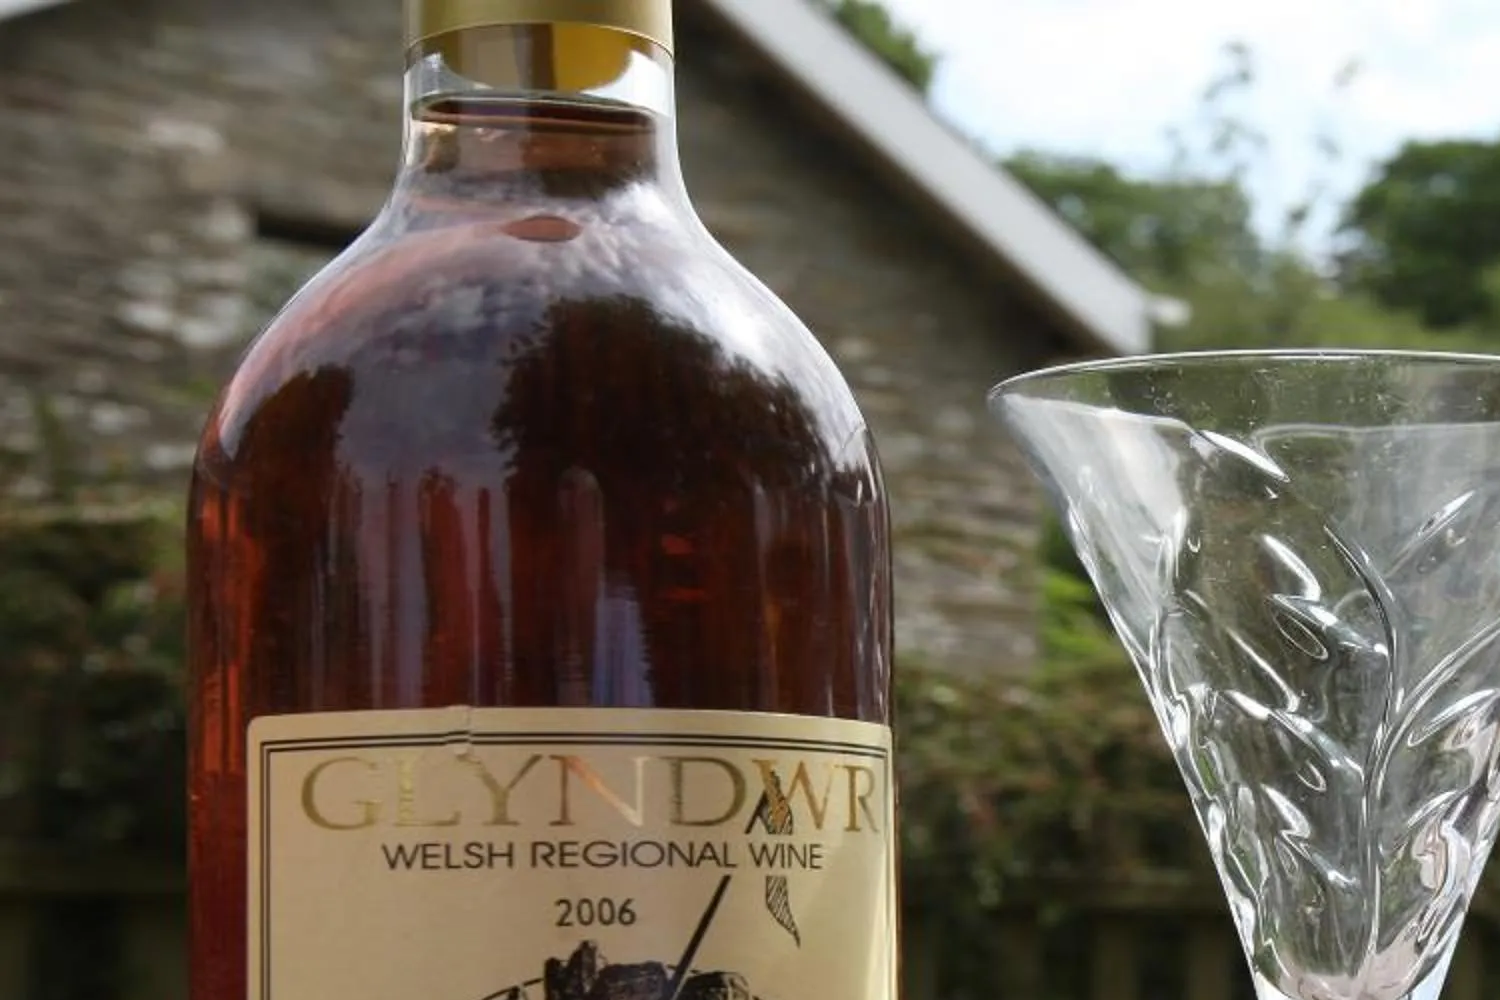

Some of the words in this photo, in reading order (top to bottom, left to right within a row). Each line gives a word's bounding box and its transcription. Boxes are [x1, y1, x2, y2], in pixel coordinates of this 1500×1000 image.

[300, 754, 880, 833] GLYNDWR
[381, 841, 513, 870] WELSH
[530, 840, 737, 869] REGIONAL
[748, 842, 825, 869] WINE
[554, 897, 637, 928] 2006
